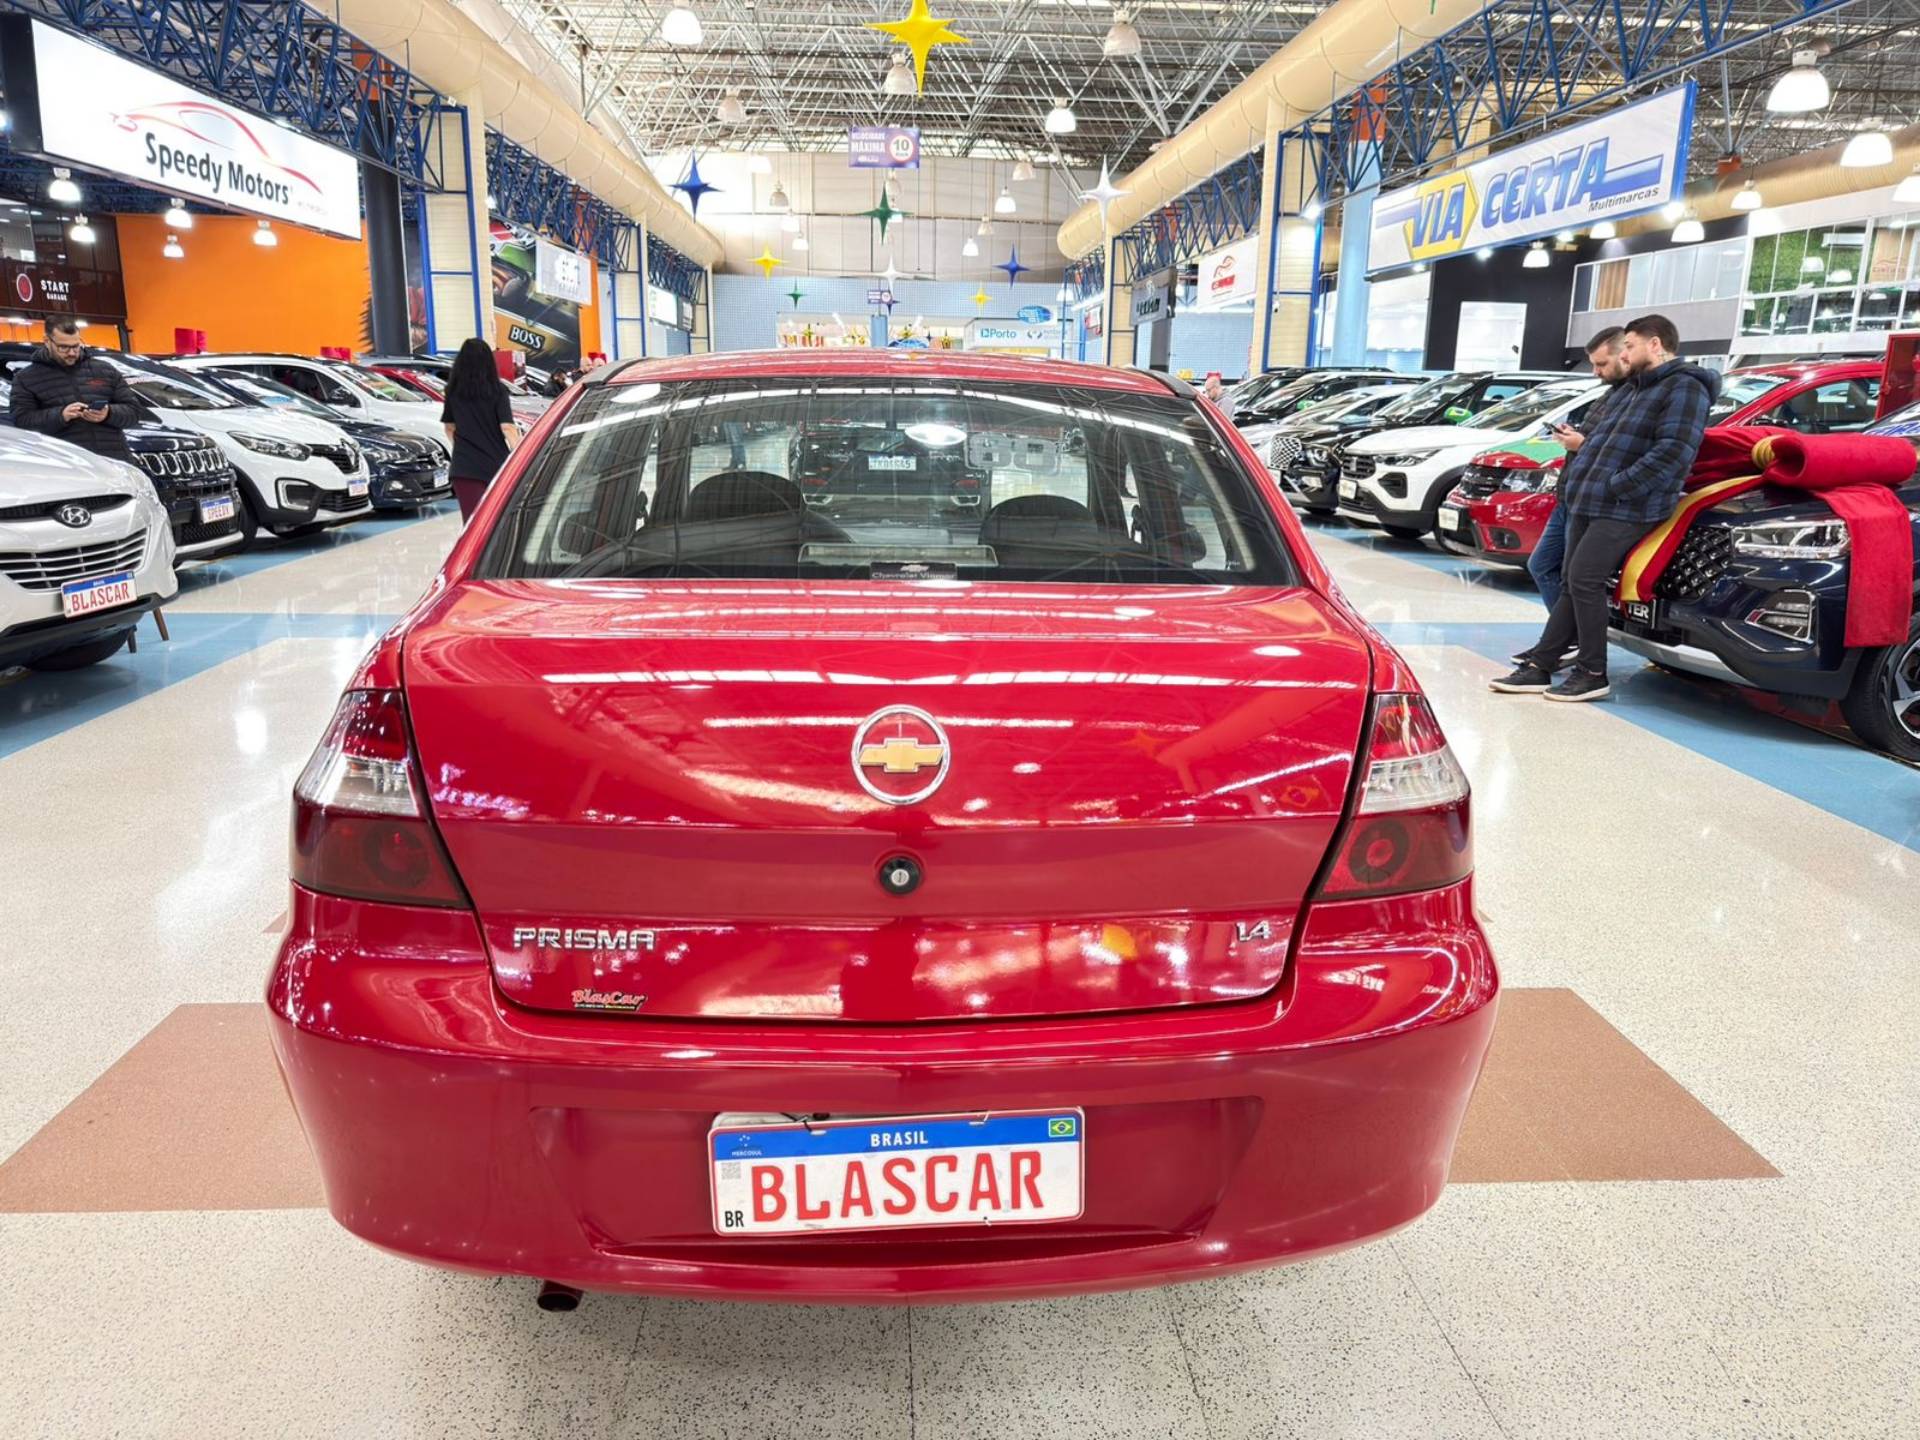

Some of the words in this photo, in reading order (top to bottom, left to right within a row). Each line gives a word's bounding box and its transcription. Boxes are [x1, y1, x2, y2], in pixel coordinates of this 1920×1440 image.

[850, 140, 886, 153] MÁXIMA
[893, 139, 910, 152] 10
[144, 132, 222, 194] Speedy
[228, 161, 290, 205] Motors
[1412, 181, 1466, 248] VIA
[1481, 136, 1611, 230] CERTA
[1588, 185, 1660, 214] Multimarcas
[40, 279, 69, 293] START
[510, 326, 542, 350] BOSS
[990, 328, 1017, 339] Porto
[71, 582, 130, 612] BLASCAR
[513, 927, 656, 950] PRISMA
[571, 988, 645, 1006] BlasCar
[870, 1132, 929, 1148] BRASIL
[751, 1151, 1044, 1222] BLASCAR
[724, 1210, 744, 1228] BR
